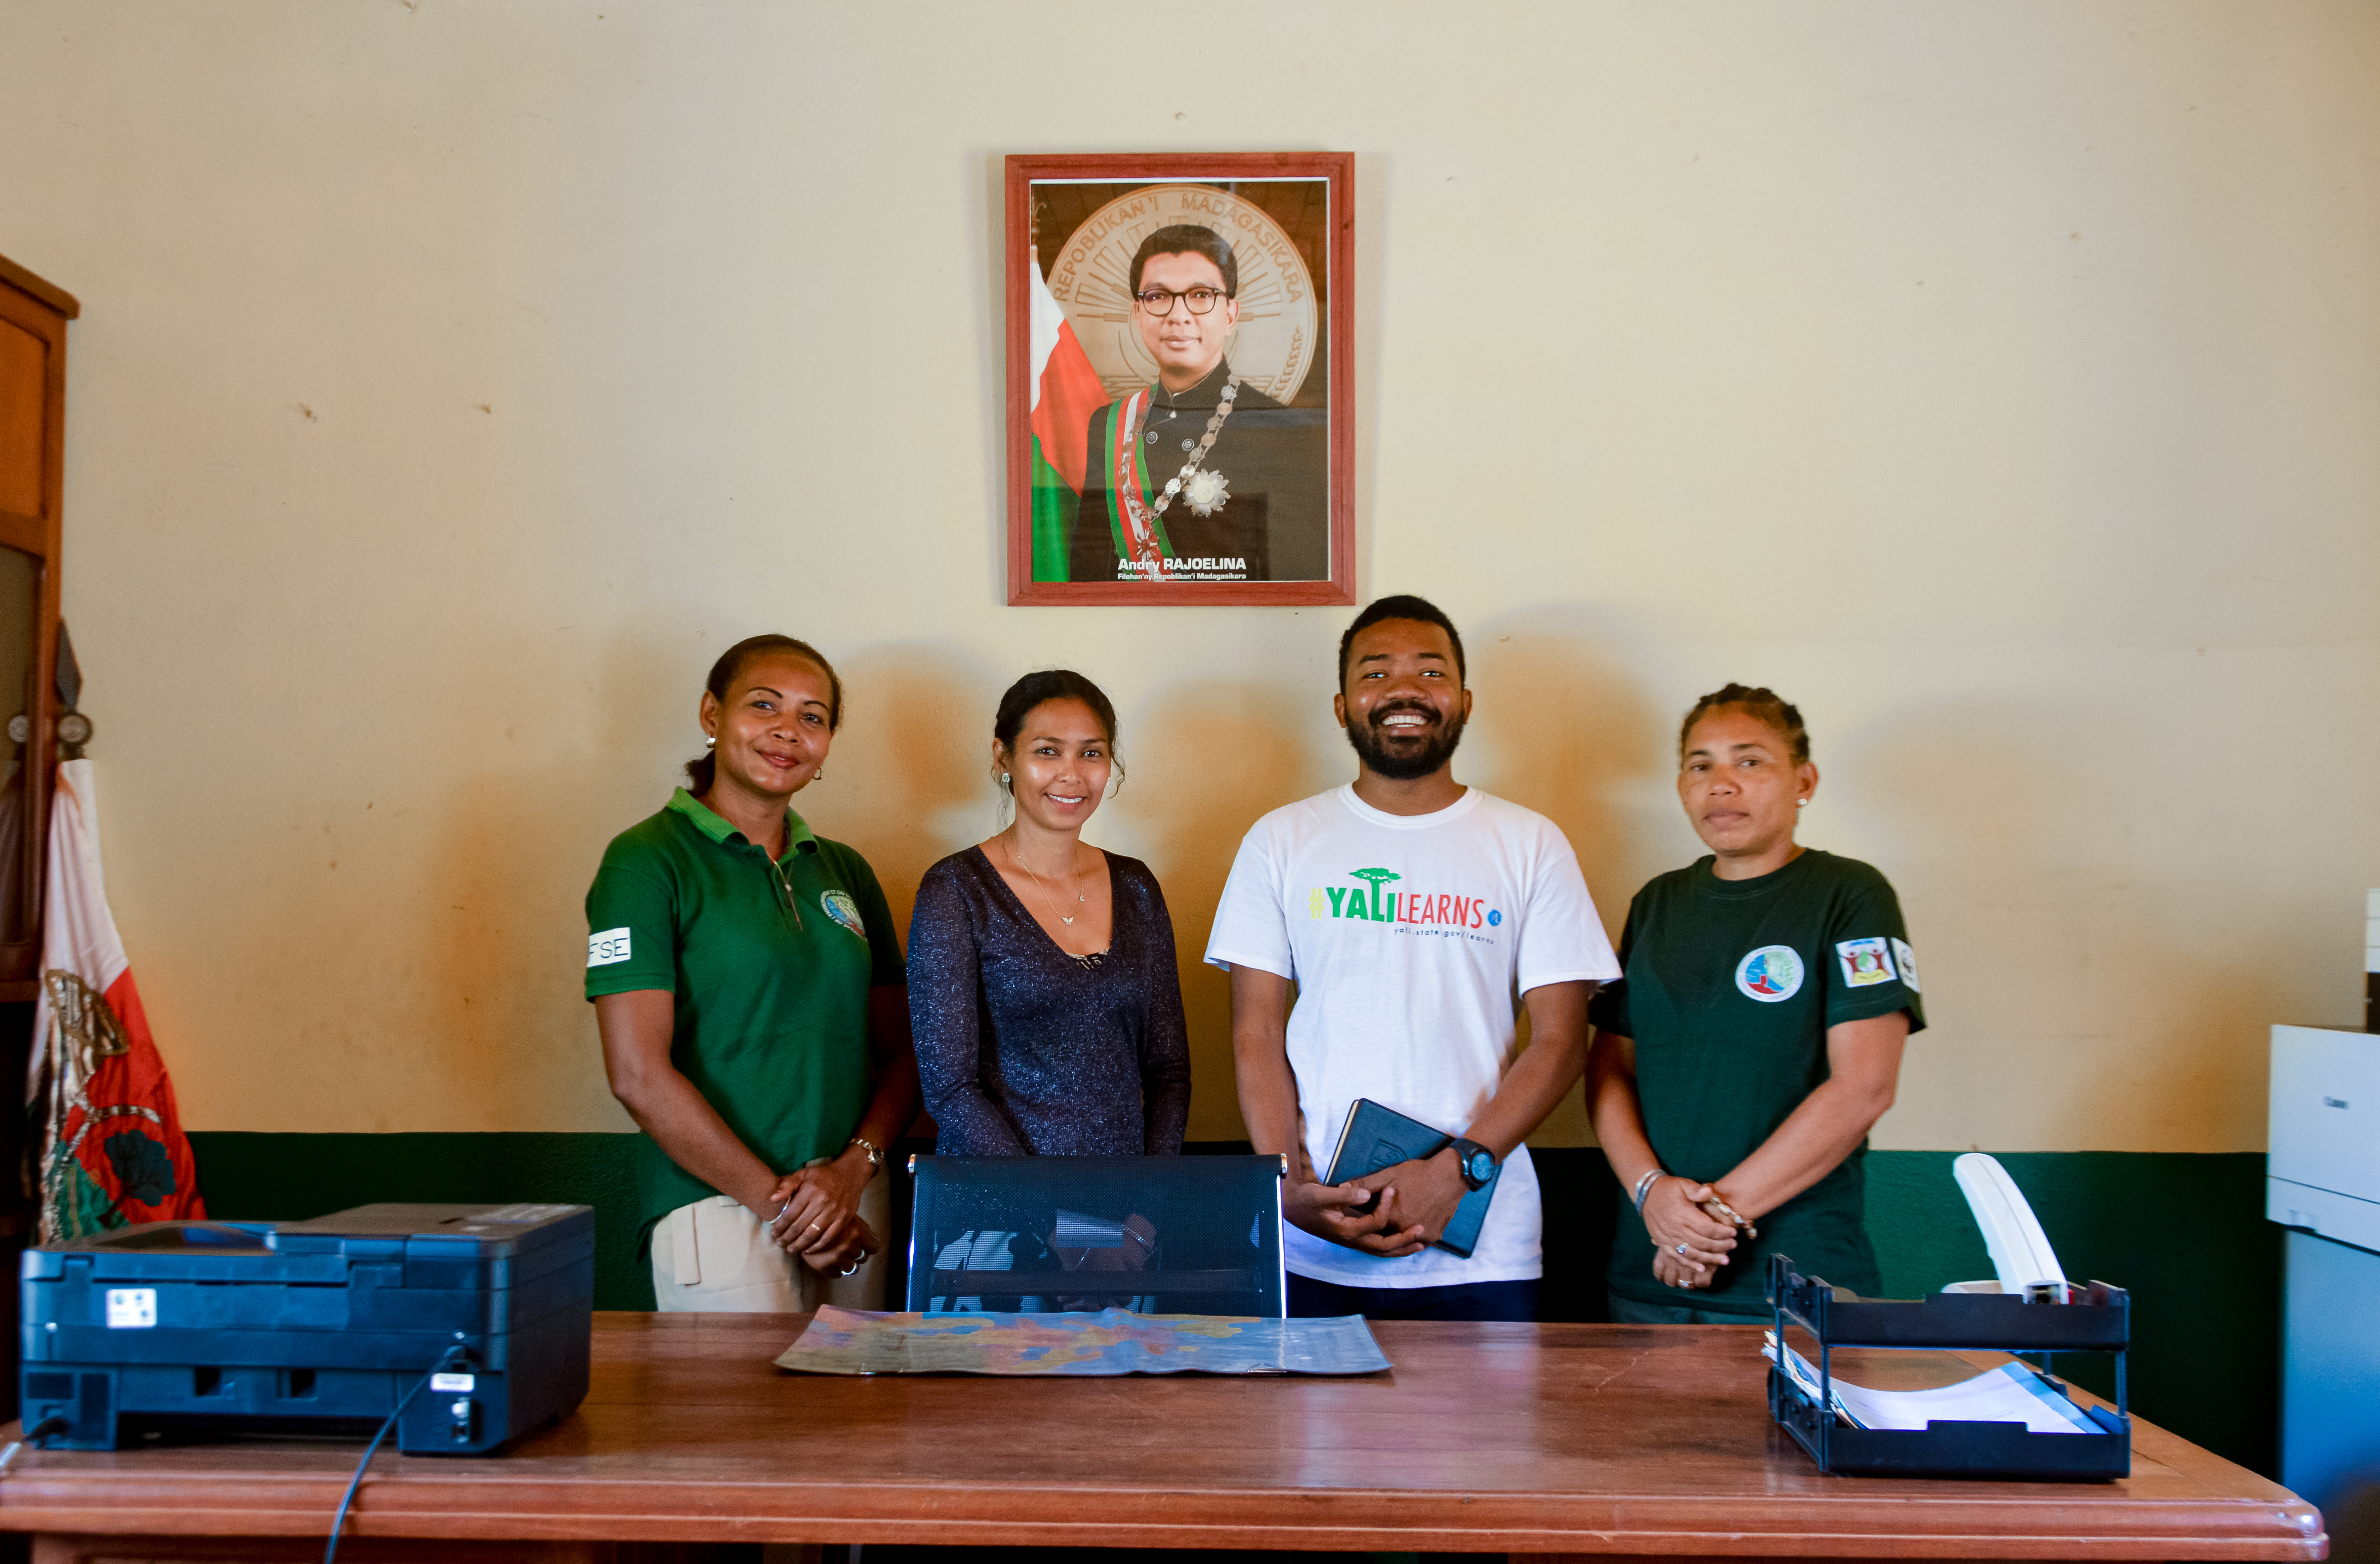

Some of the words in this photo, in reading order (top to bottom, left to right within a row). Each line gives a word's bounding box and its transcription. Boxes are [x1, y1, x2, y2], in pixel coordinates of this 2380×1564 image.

[1181, 193, 1303, 303] MADAGASIKARA
[1118, 558, 1160, 573] Andry
[1164, 558, 1246, 570] RAJOELINA
[1154, 573, 1195, 581] Repoblikan'i
[1394, 926, 1494, 944] yali.state.gov/learns
